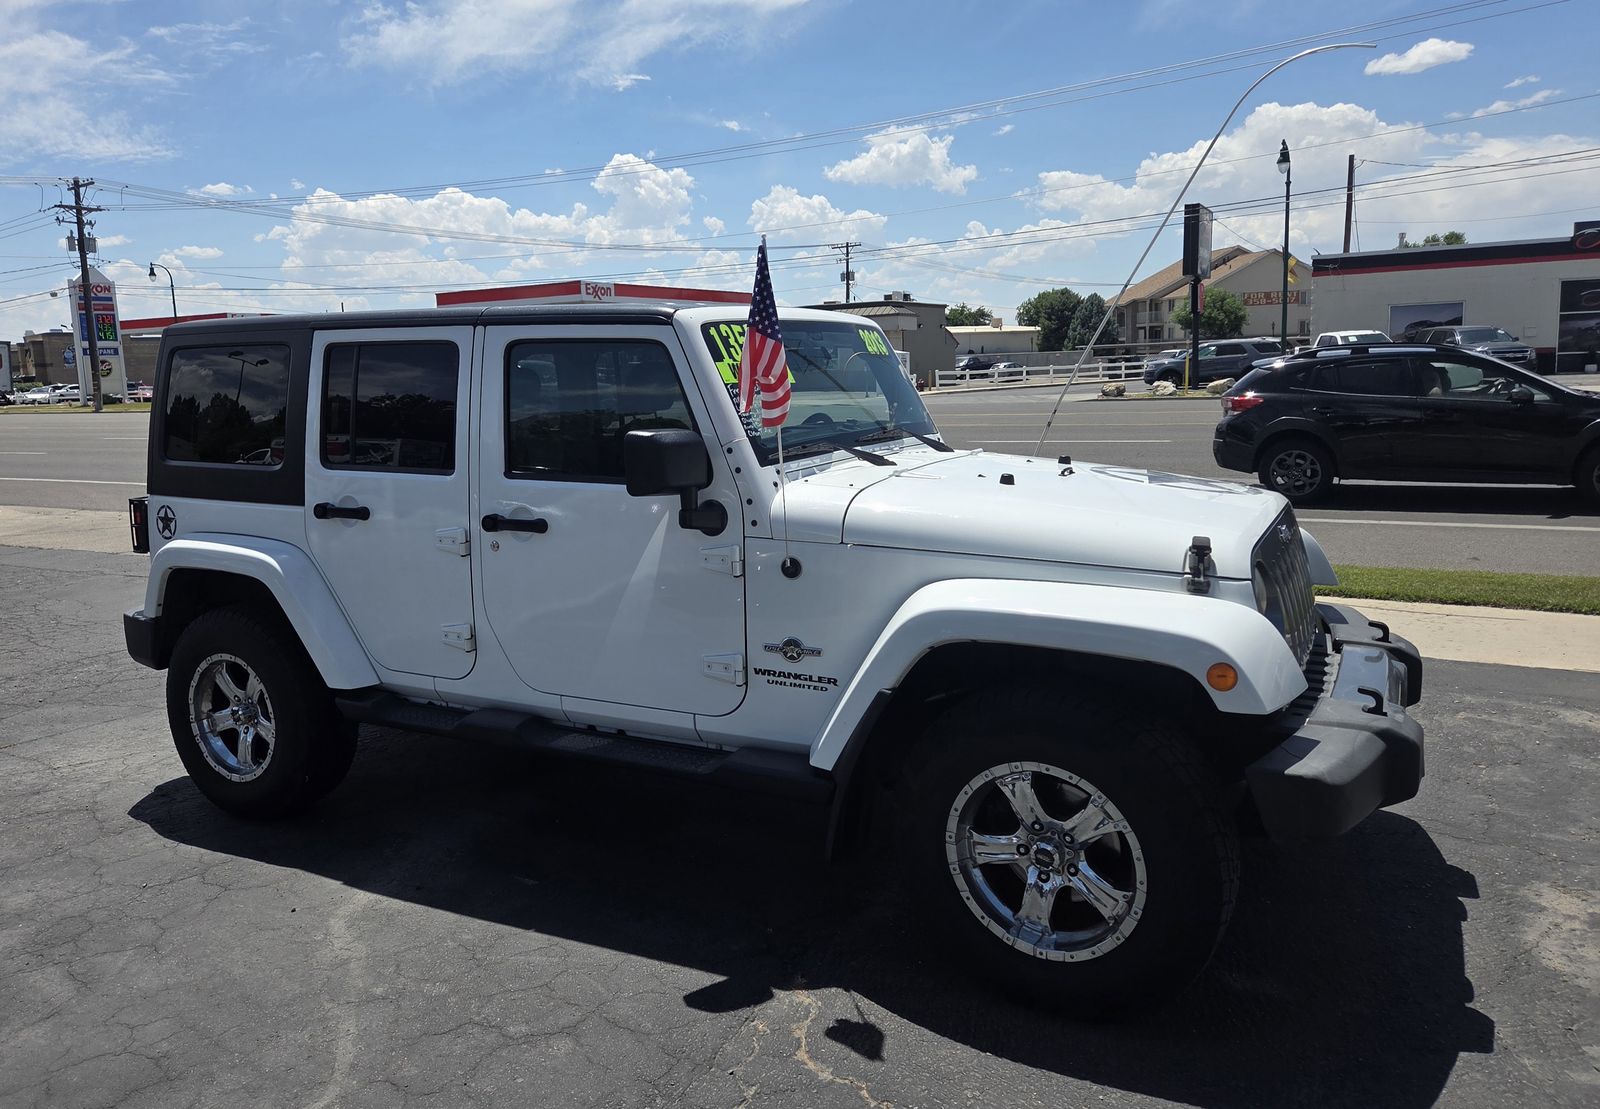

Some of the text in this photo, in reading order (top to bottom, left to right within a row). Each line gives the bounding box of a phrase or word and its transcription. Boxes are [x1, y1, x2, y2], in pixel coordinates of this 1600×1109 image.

[585, 282, 612, 300] Exxon
[753, 667, 839, 687] WRANGLER
[766, 679, 828, 692] UNLIMITED
